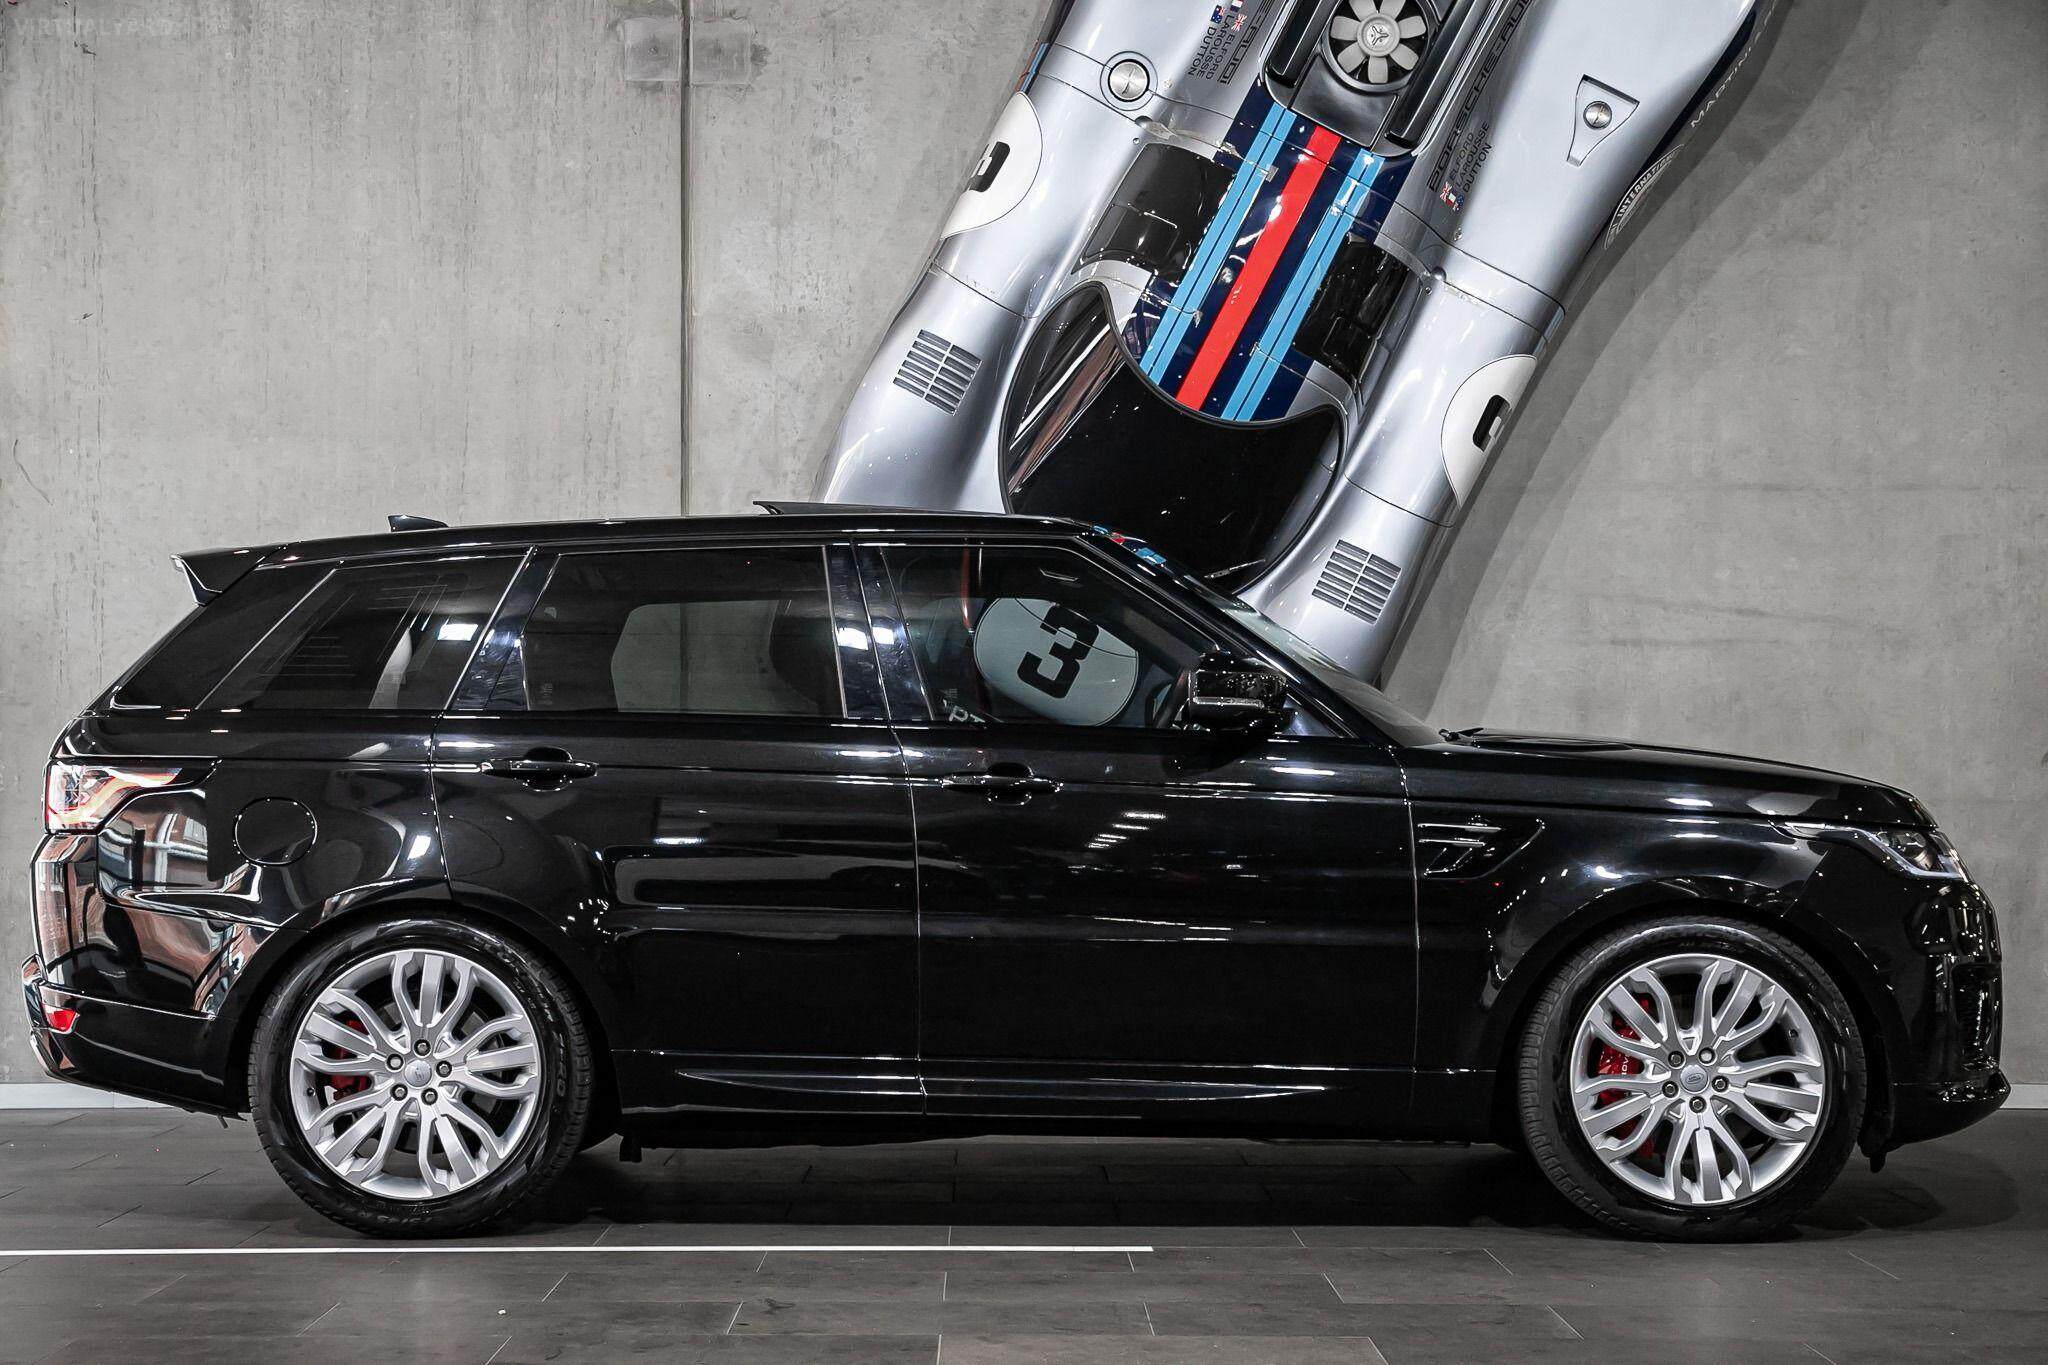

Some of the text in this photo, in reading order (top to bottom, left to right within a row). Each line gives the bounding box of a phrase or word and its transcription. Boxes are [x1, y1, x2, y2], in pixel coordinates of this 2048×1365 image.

[1187, 26, 1217, 76] DUTTON
[1197, 14, 1236, 78] LAROUSSE
[1205, 33, 1237, 80] ELFORD
[1449, 132, 1475, 180] ELFORD
[1456, 121, 1490, 188] LAROUSSE
[1462, 142, 1493, 193] DUTTON
[1017, 605, 1100, 699] 3
